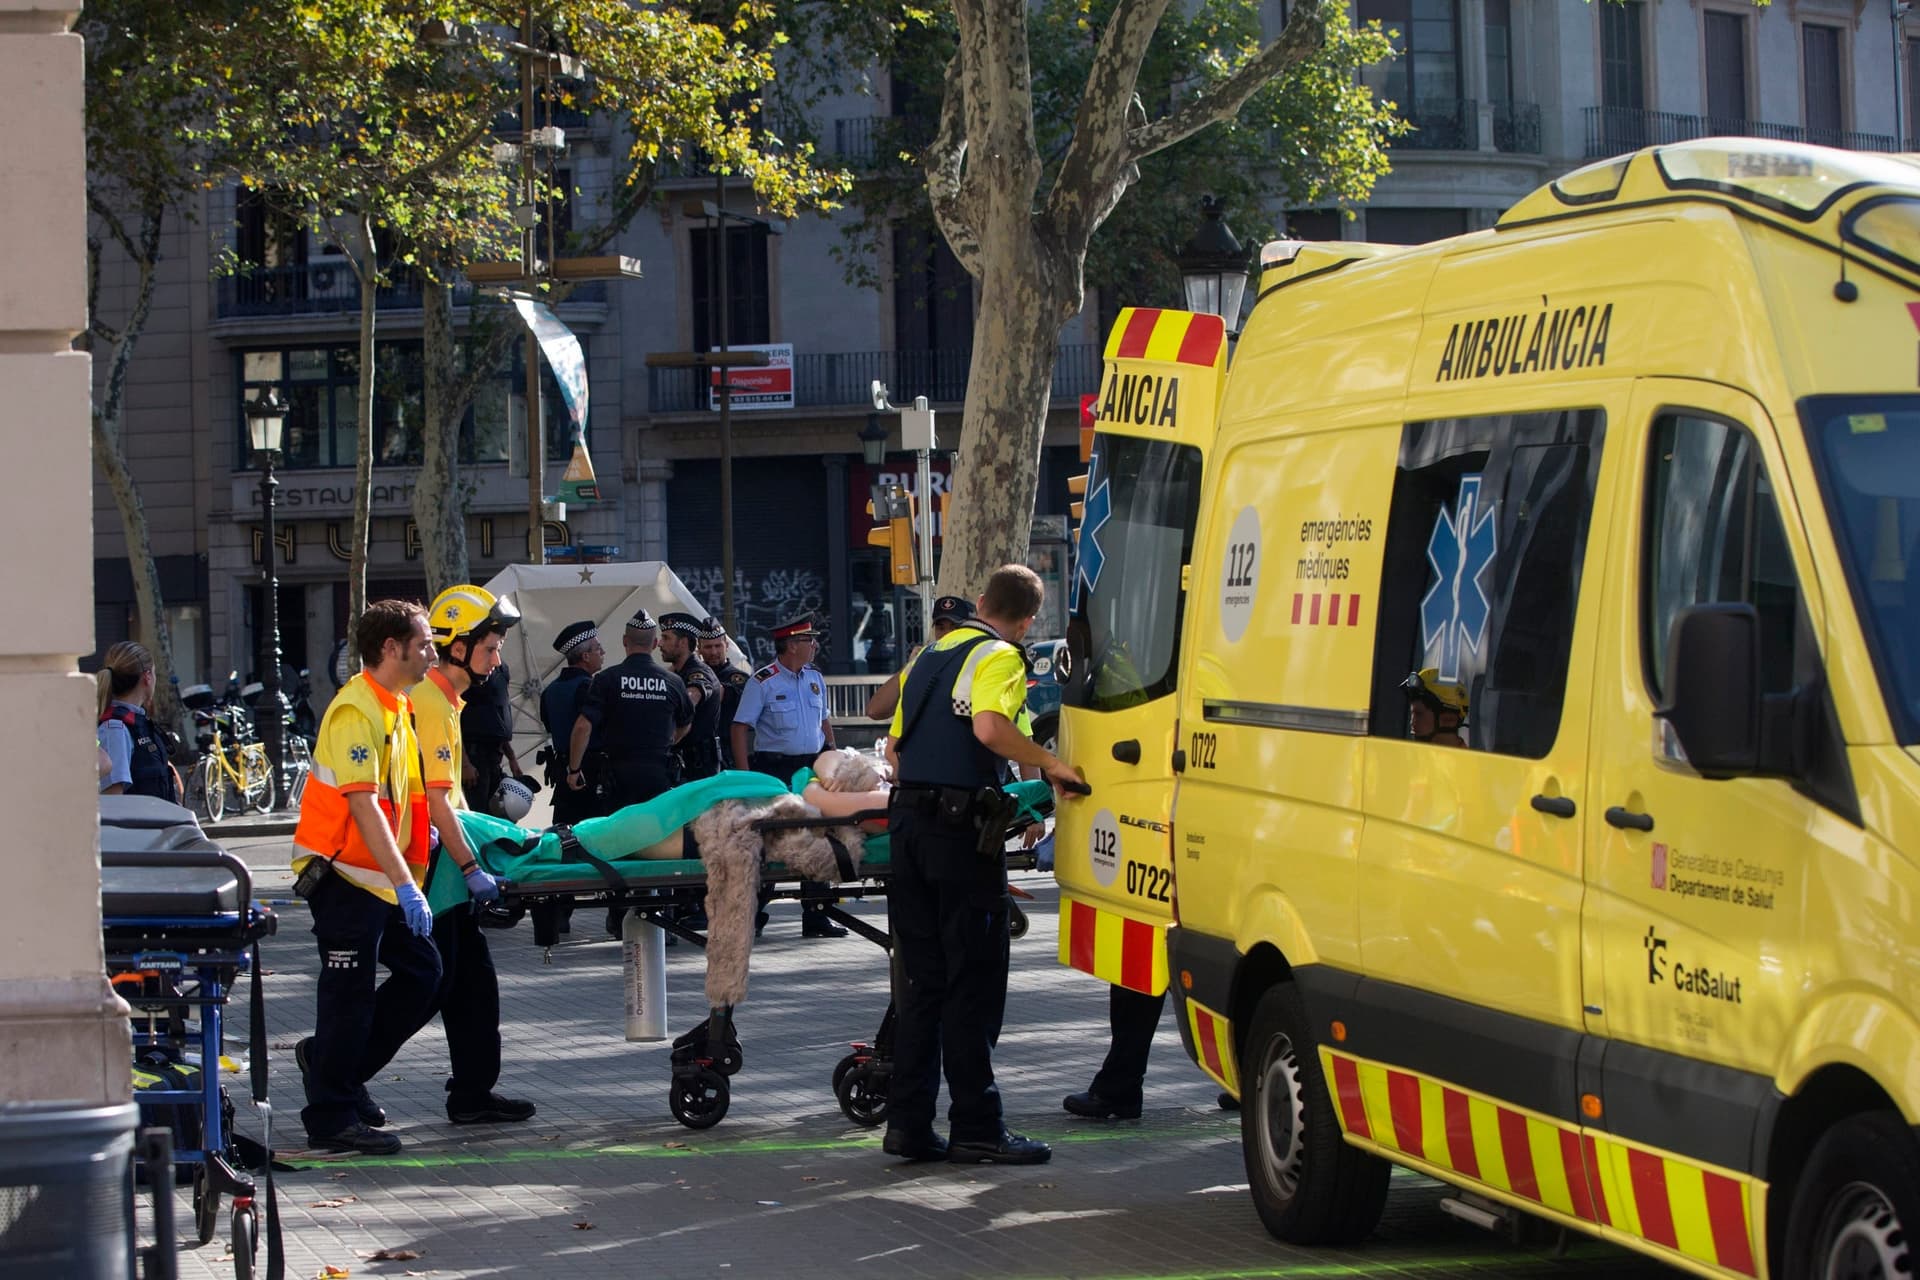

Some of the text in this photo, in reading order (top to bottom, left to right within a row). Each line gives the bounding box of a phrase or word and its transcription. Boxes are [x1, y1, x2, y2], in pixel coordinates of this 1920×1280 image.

[1436, 294, 1613, 382] AMBULÀNCIA
[1096, 363, 1178, 427] ÀNCIA
[252, 484, 415, 506] RESTAUANT
[1301, 512, 1373, 549] emergències
[1227, 543, 1255, 587] 112
[1296, 551, 1350, 587] mèdiques
[621, 676, 667, 692] POLICIA
[1191, 732, 1217, 769] 0722
[1094, 828, 1116, 857] 112
[1127, 859, 1171, 903] 0722
[1670, 848, 1784, 889] Generalitat de Catalunya
[1670, 874, 1773, 909] Departament de Salut
[1674, 963, 1741, 1004] CatSalut
